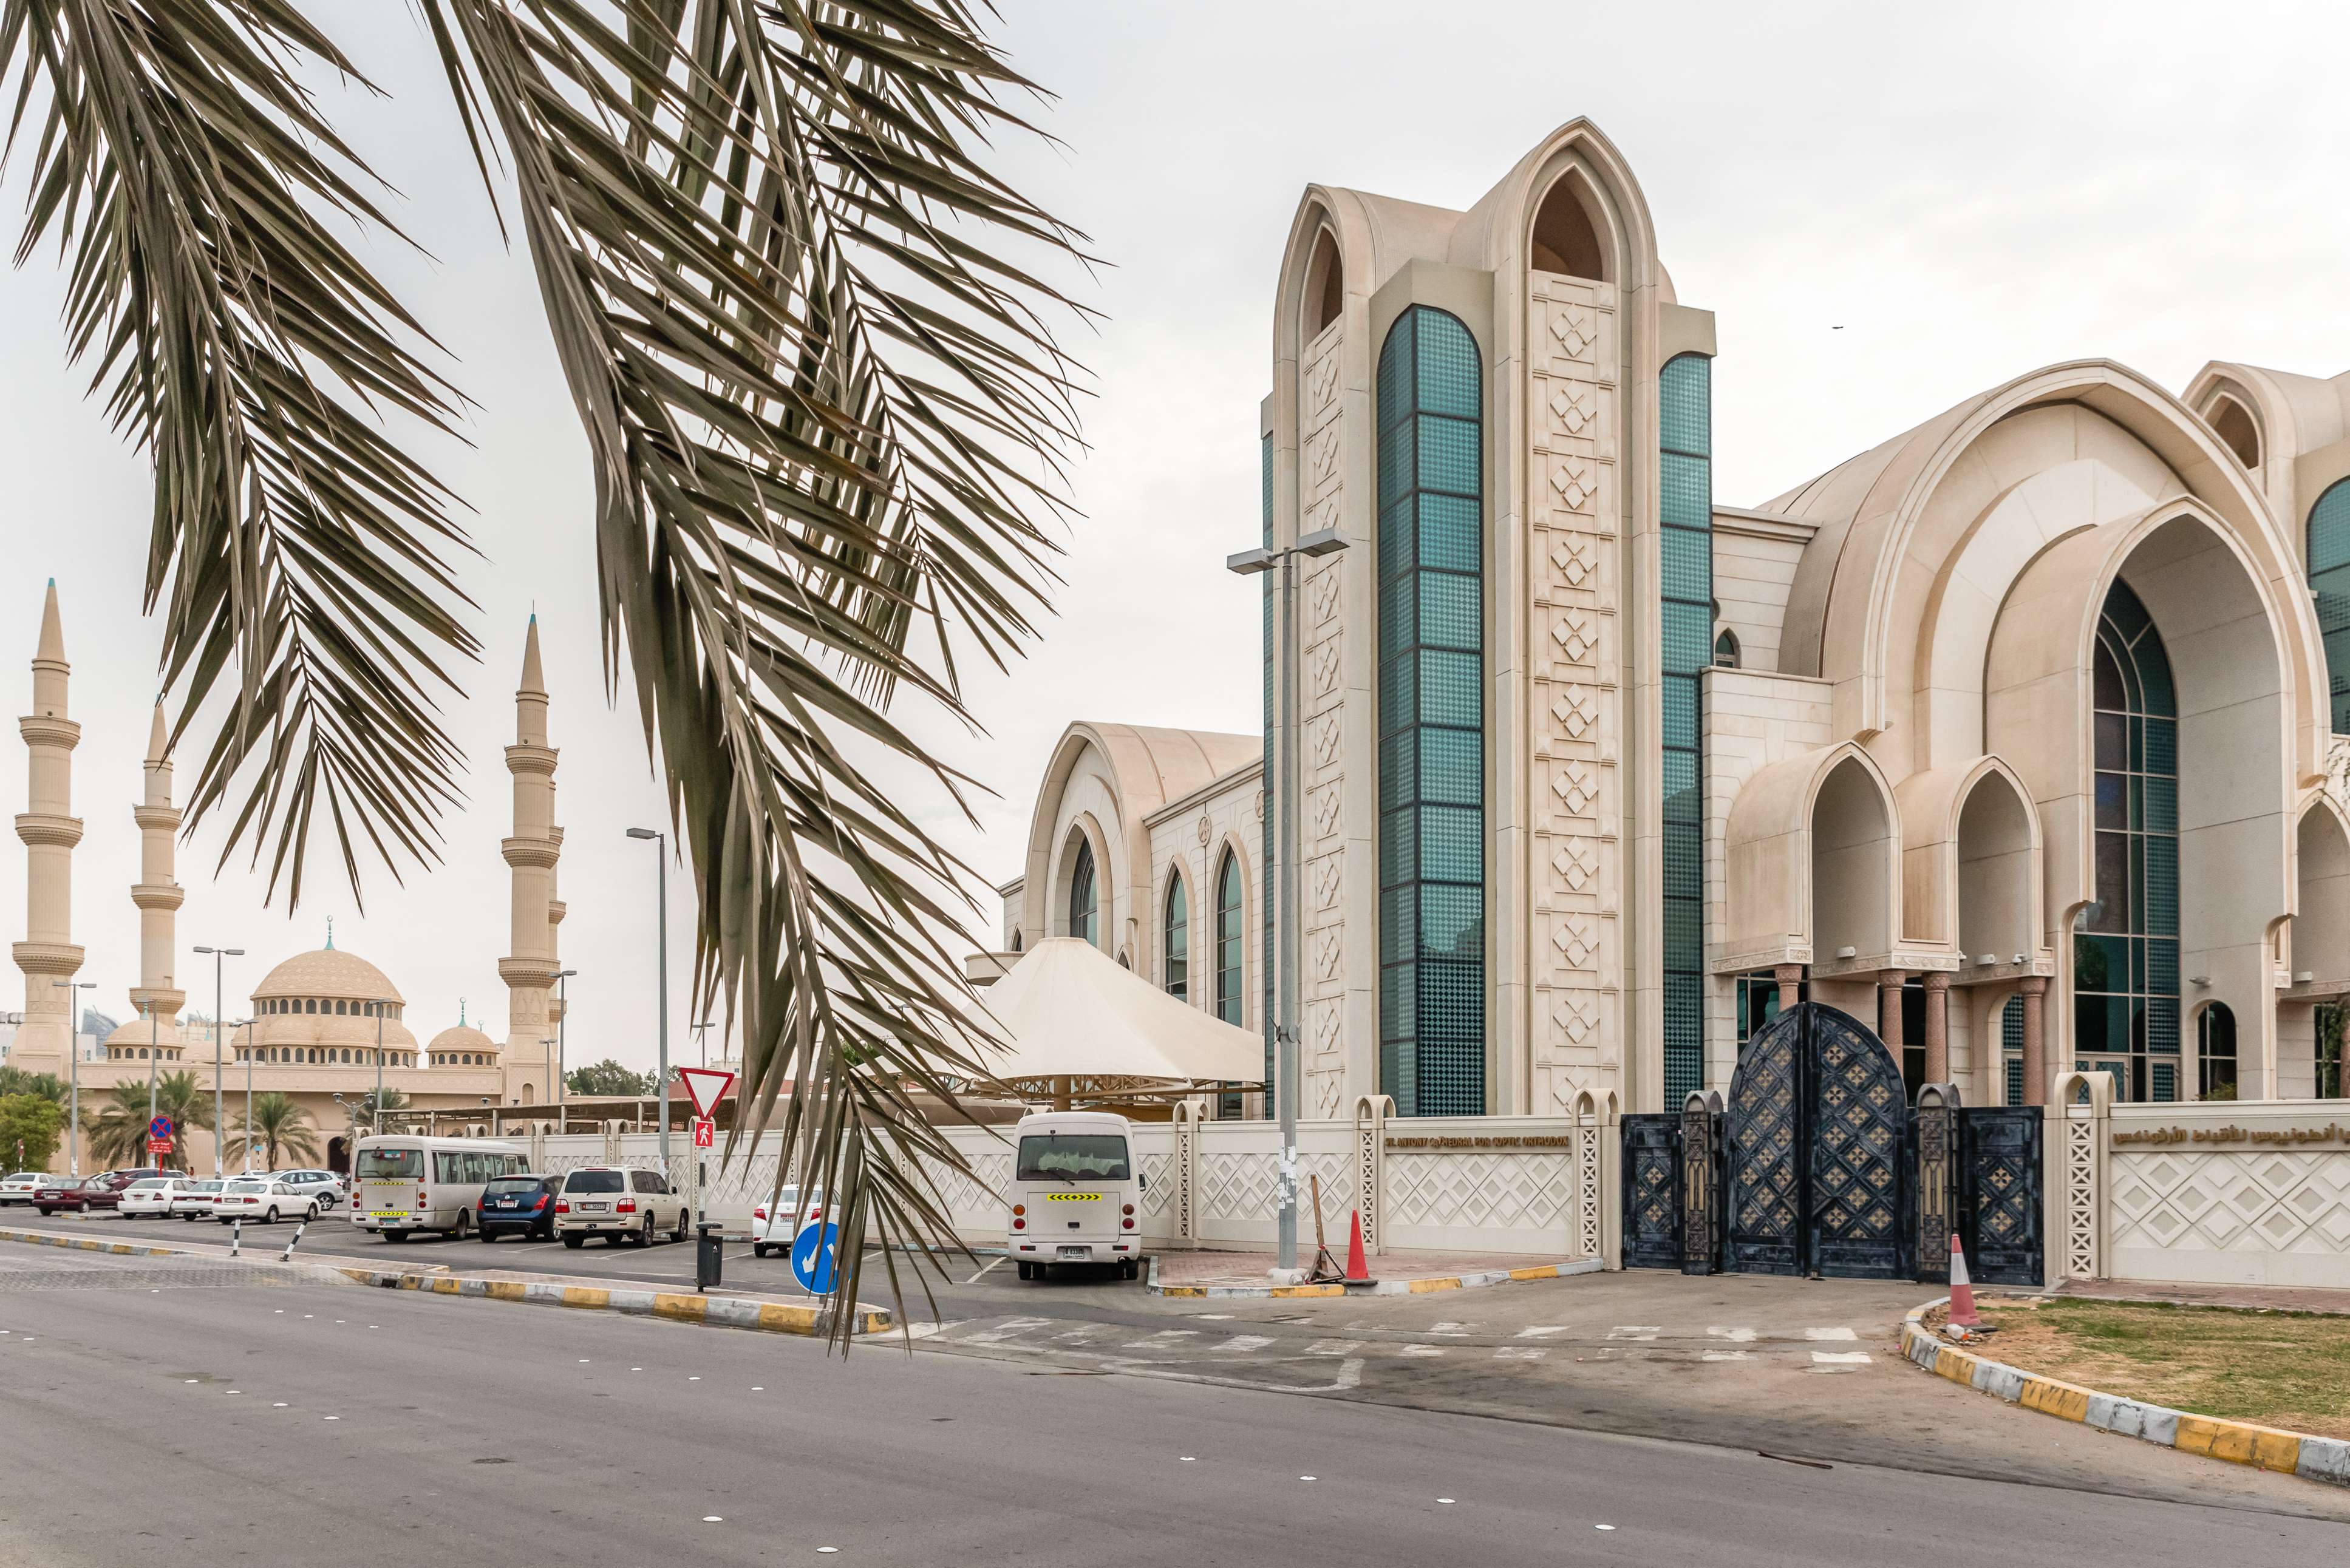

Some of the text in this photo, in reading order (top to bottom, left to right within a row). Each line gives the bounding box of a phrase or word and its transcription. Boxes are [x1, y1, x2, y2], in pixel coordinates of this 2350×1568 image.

[1385, 1136, 1568, 1147] ST. ANTONY CATHEDRAL FOR COPTIC ORTHODOX
[2192, 1125, 2247, 1144] للأقباط
[2250, 1123, 2334, 1145] أنطونيوس
